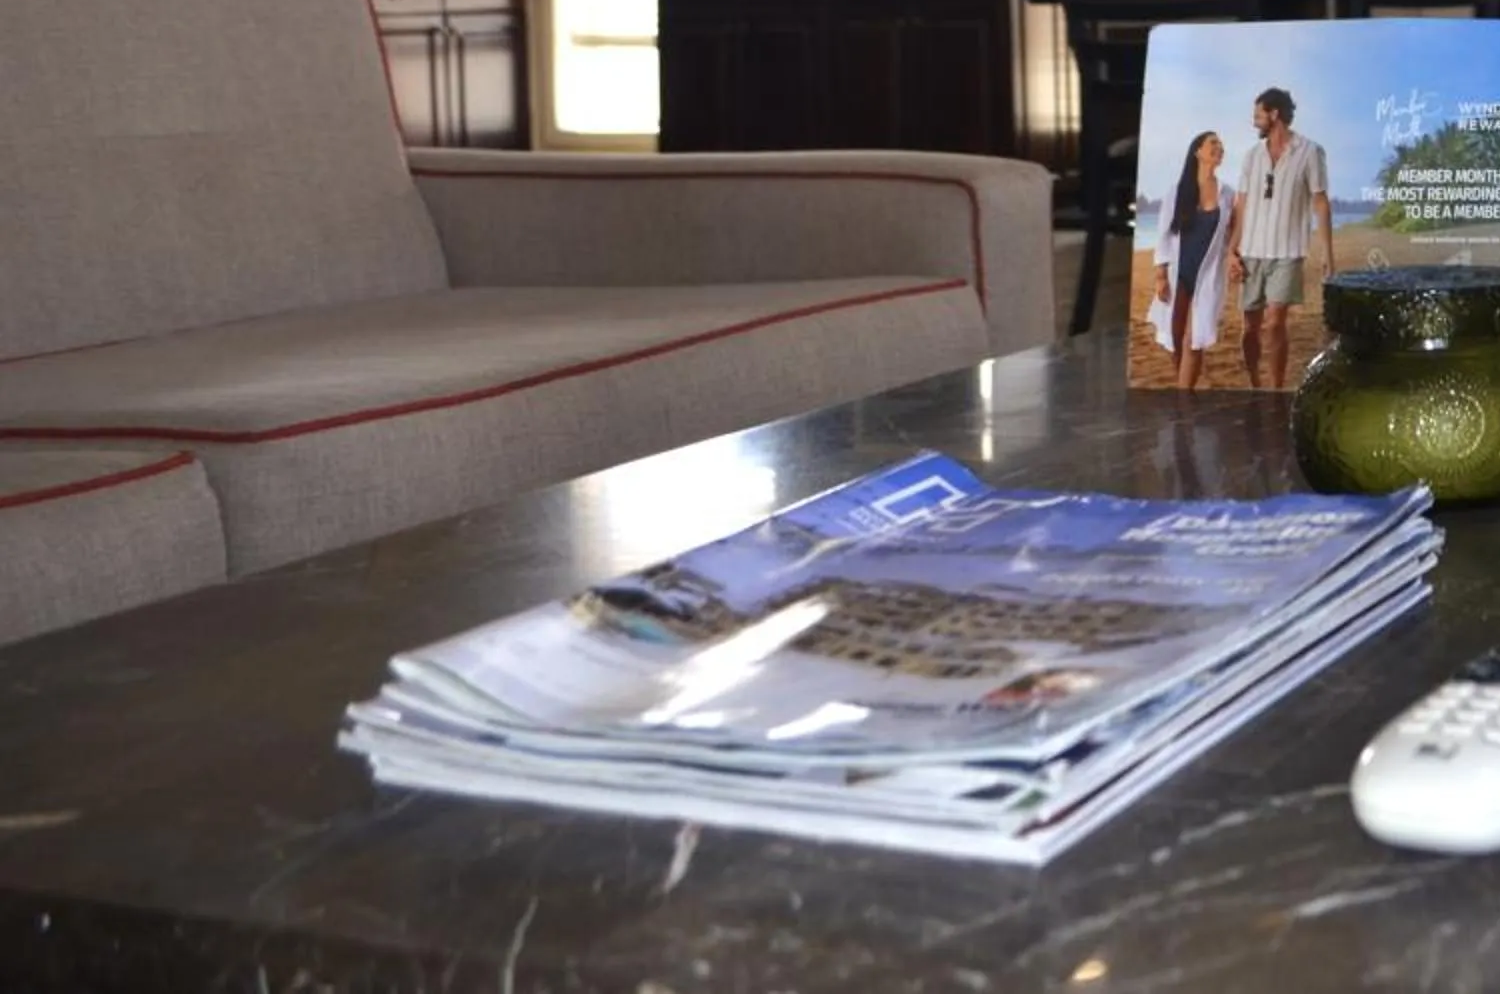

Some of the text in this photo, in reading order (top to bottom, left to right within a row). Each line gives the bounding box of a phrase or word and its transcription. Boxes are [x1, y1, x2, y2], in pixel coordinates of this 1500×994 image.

[1397, 169, 1452, 183] MEMBER
[1361, 186, 1385, 201] THE
[1387, 186, 1424, 201] MOST
[1405, 205, 1421, 219] TO
[1424, 205, 1440, 219] BE
[1441, 205, 1451, 219] A
